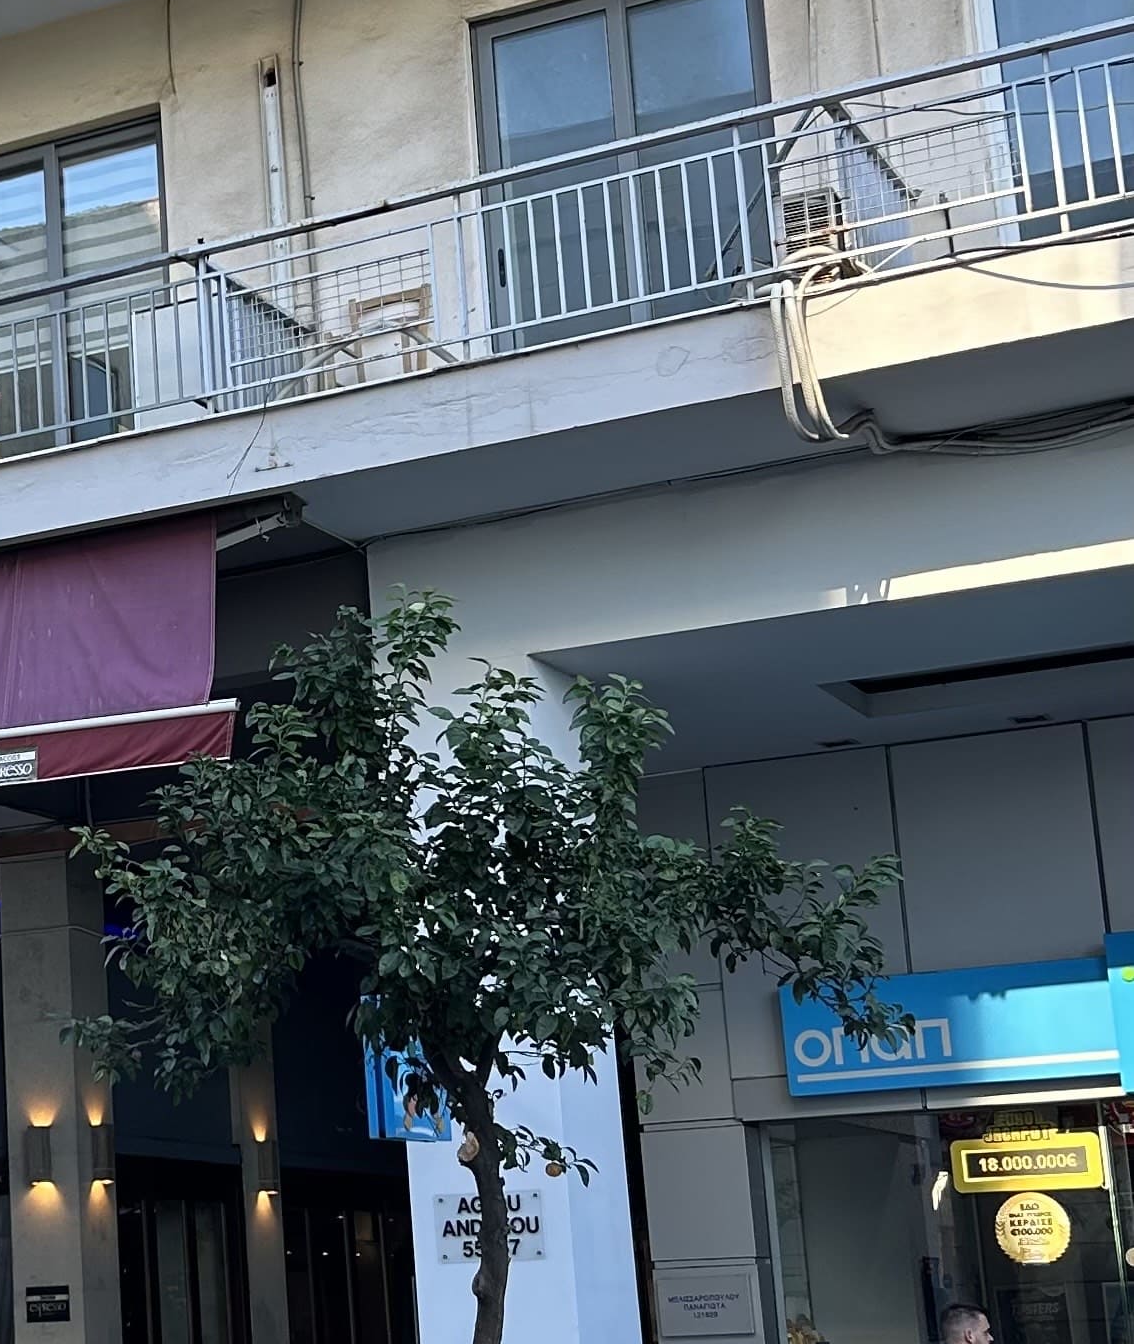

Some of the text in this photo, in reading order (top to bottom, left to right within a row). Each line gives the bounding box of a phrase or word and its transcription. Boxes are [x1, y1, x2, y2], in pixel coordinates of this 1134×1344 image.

[978, 1152, 1079, 1173] 18.000.000€
[457, 1194, 522, 1215] AGU
[442, 1215, 540, 1238] ANDOU
